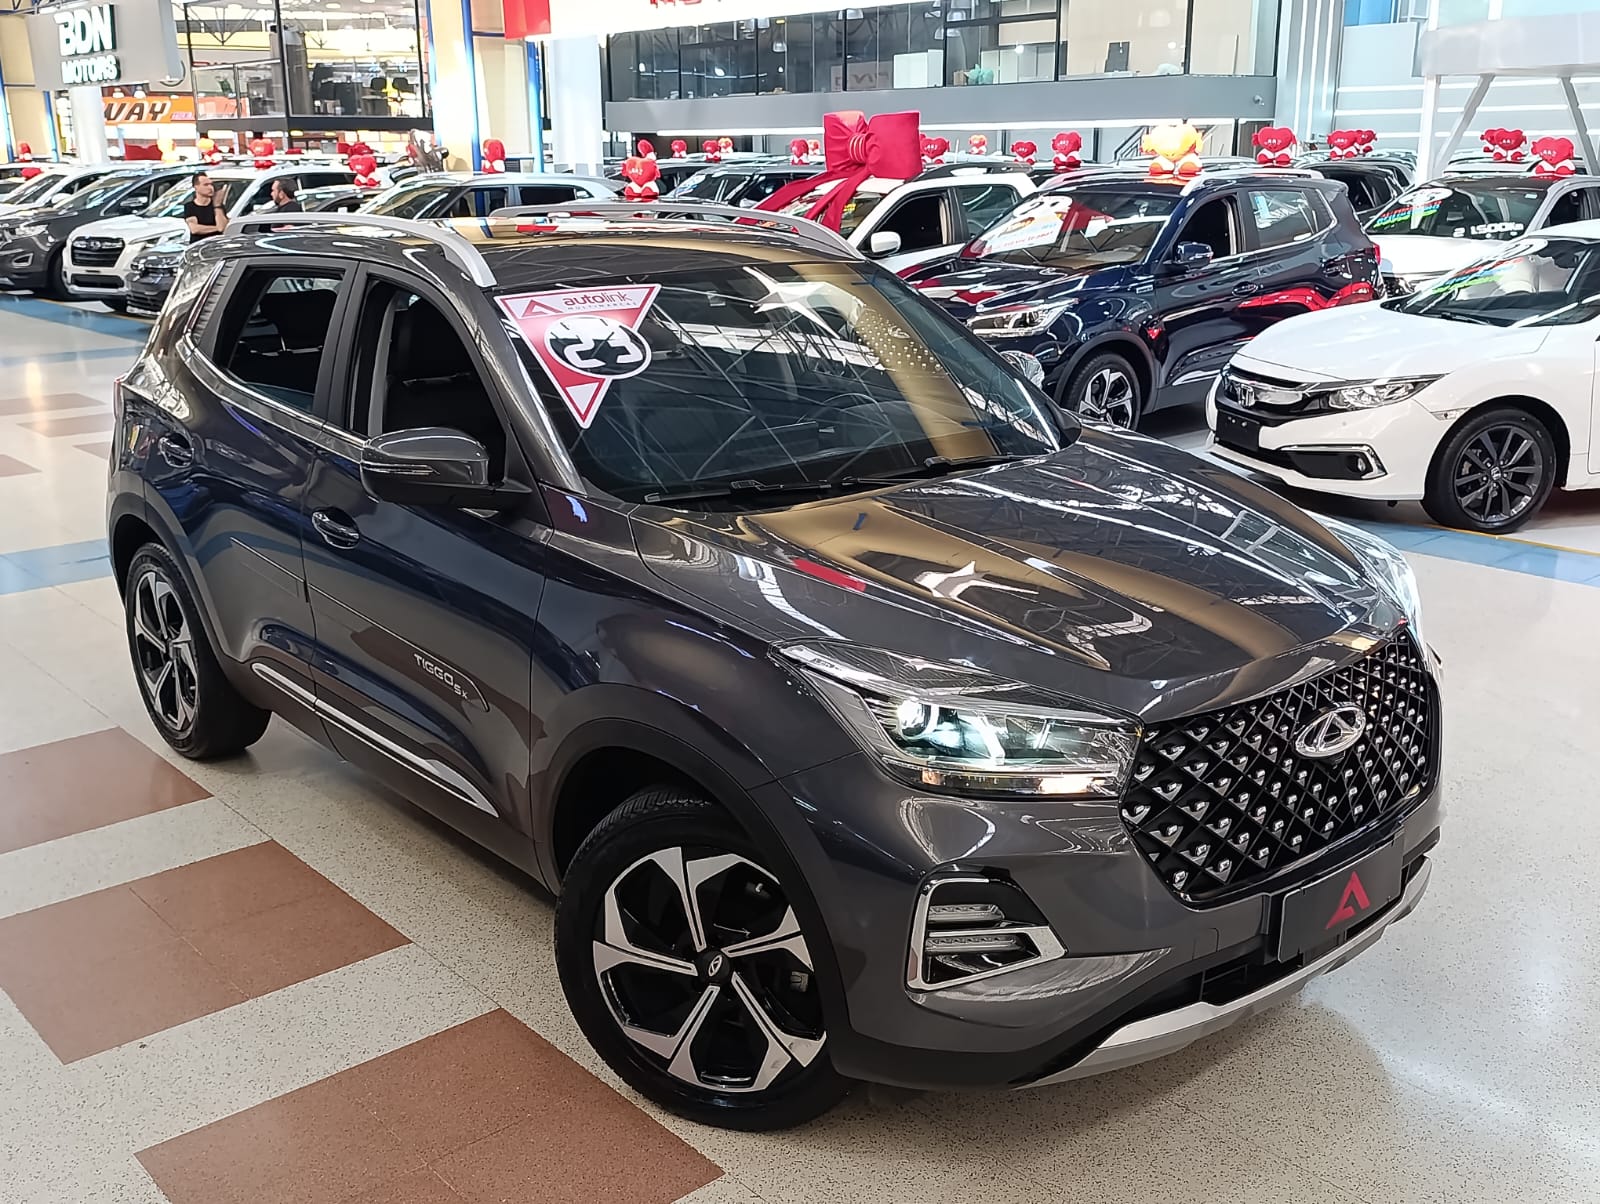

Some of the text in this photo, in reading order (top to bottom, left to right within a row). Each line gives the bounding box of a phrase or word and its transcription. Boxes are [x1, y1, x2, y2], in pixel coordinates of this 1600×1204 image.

[54, 4, 114, 56] BDN
[61, 55, 118, 84] MOTORS
[562, 291, 633, 306] autolink
[559, 319, 644, 369] 23
[413, 653, 454, 687] TIGGO
